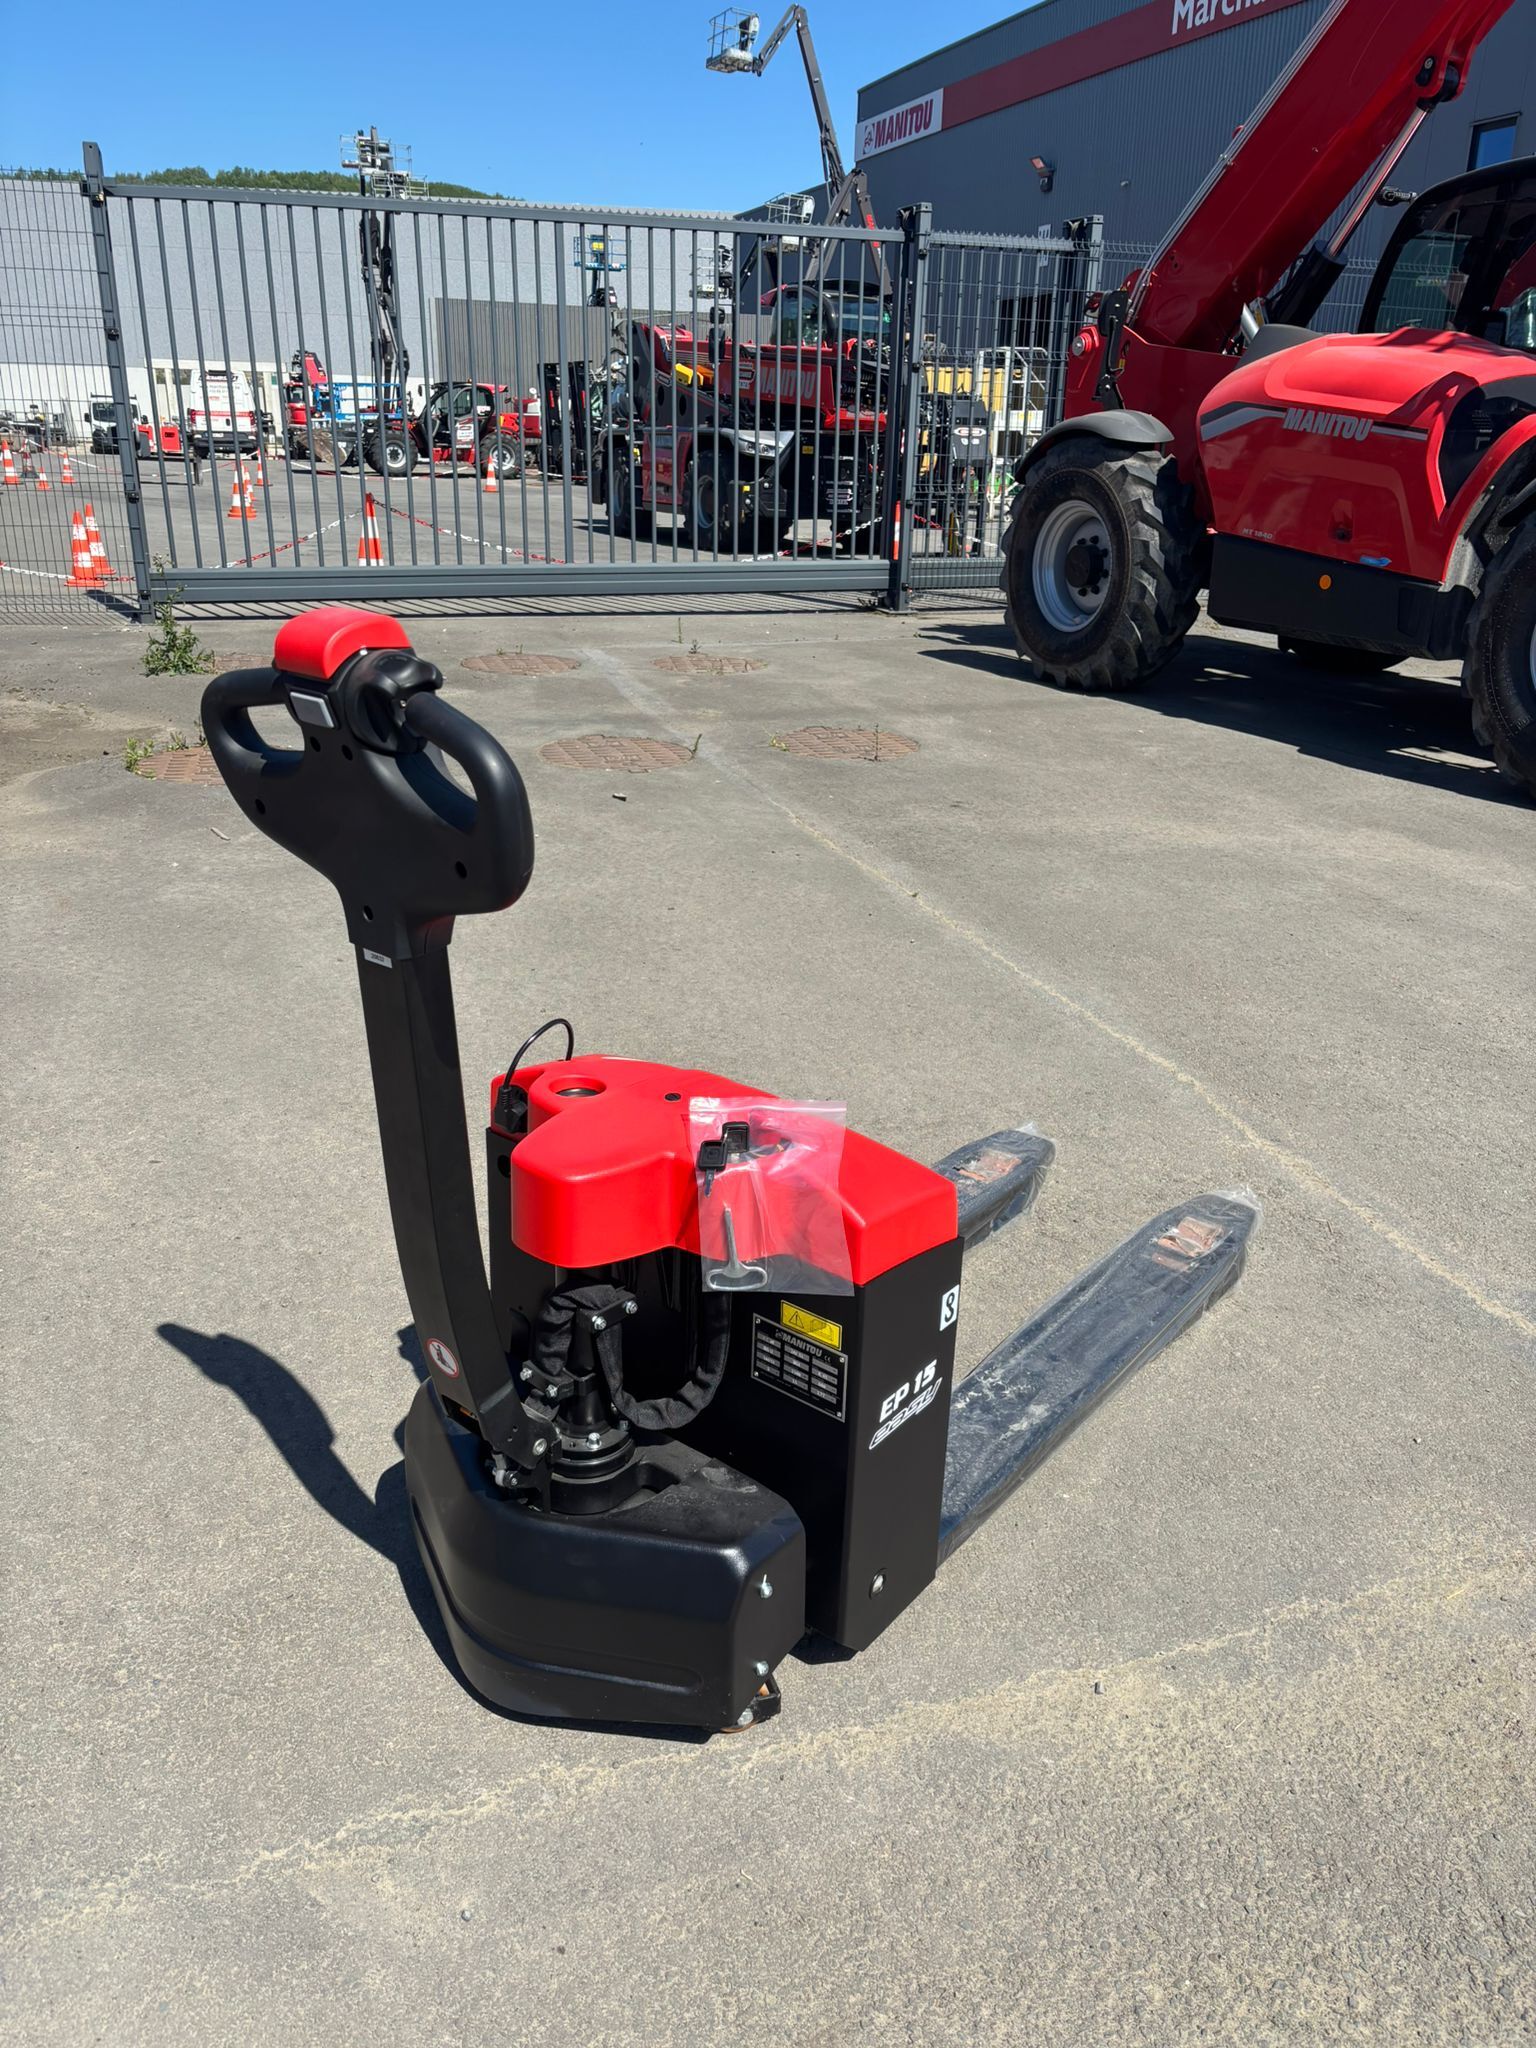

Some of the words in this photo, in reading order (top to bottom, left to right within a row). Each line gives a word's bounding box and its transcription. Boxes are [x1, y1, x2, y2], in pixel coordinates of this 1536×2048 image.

[1171, 0, 1265, 35] Marc
[874, 98, 934, 149] MANITOU
[1282, 407, 1374, 442] MANITOU
[781, 1332, 823, 1358] MANITOU
[879, 1382, 910, 1423] EP
[913, 1359, 938, 1394] 15
